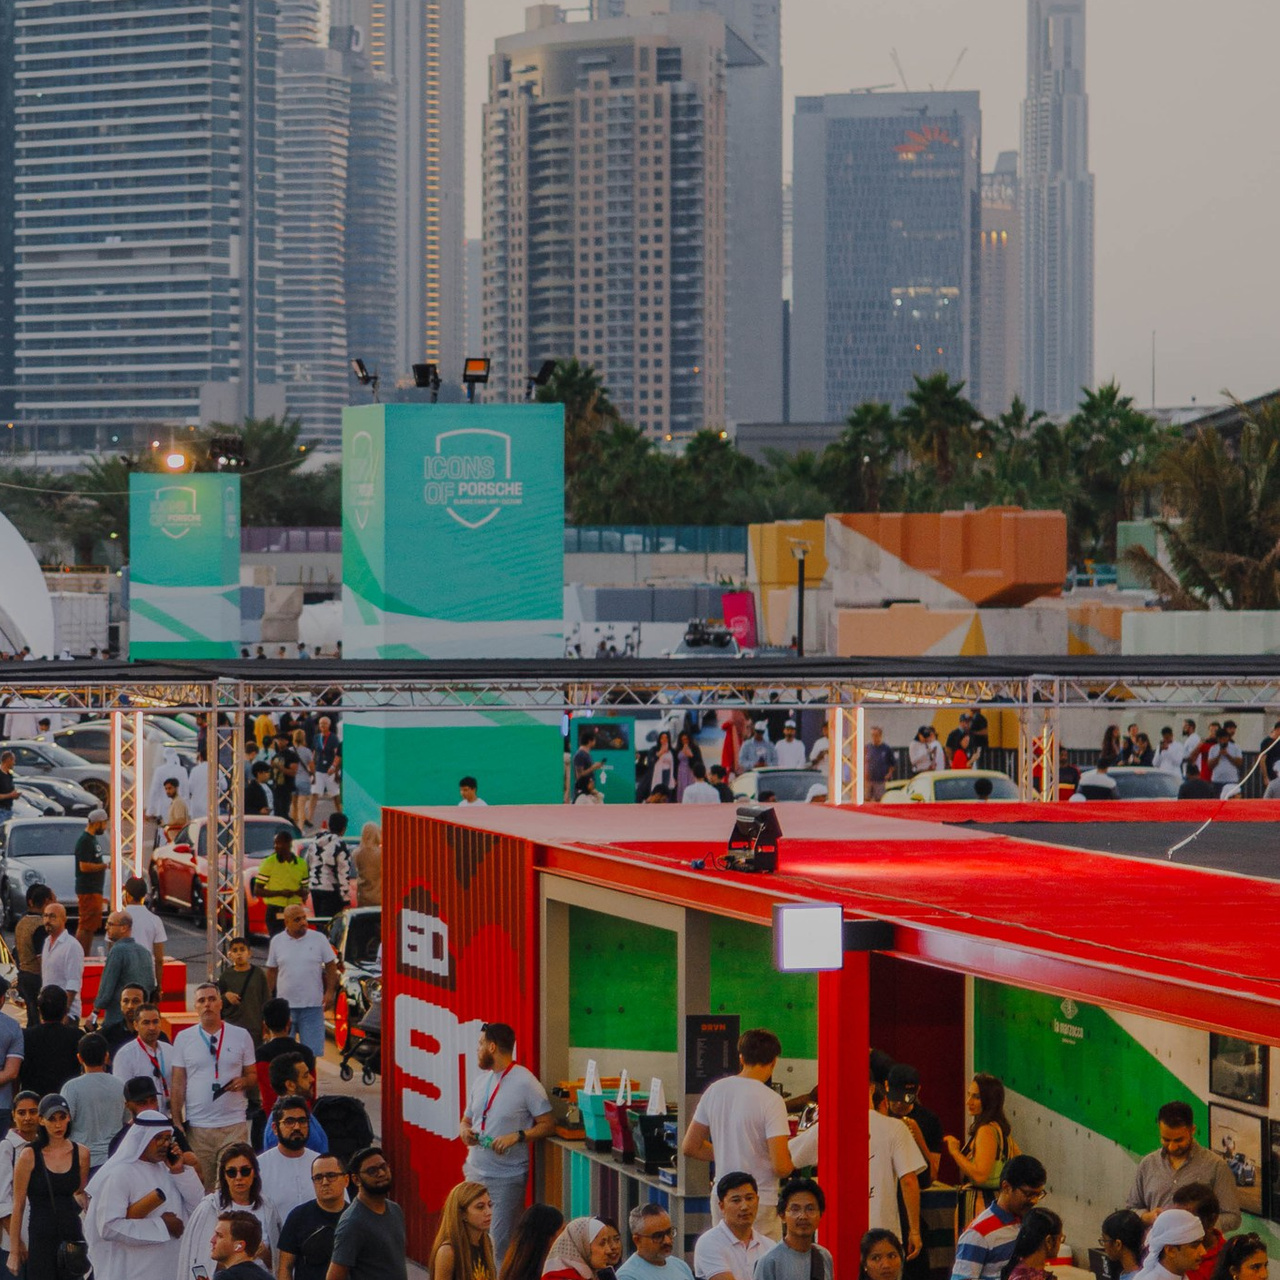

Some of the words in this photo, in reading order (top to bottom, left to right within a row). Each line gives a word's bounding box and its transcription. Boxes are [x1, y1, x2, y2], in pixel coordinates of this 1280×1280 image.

[423, 455, 496, 481] ICONS
[424, 481, 454, 505] OF
[458, 481, 523, 496] PORSCHE
